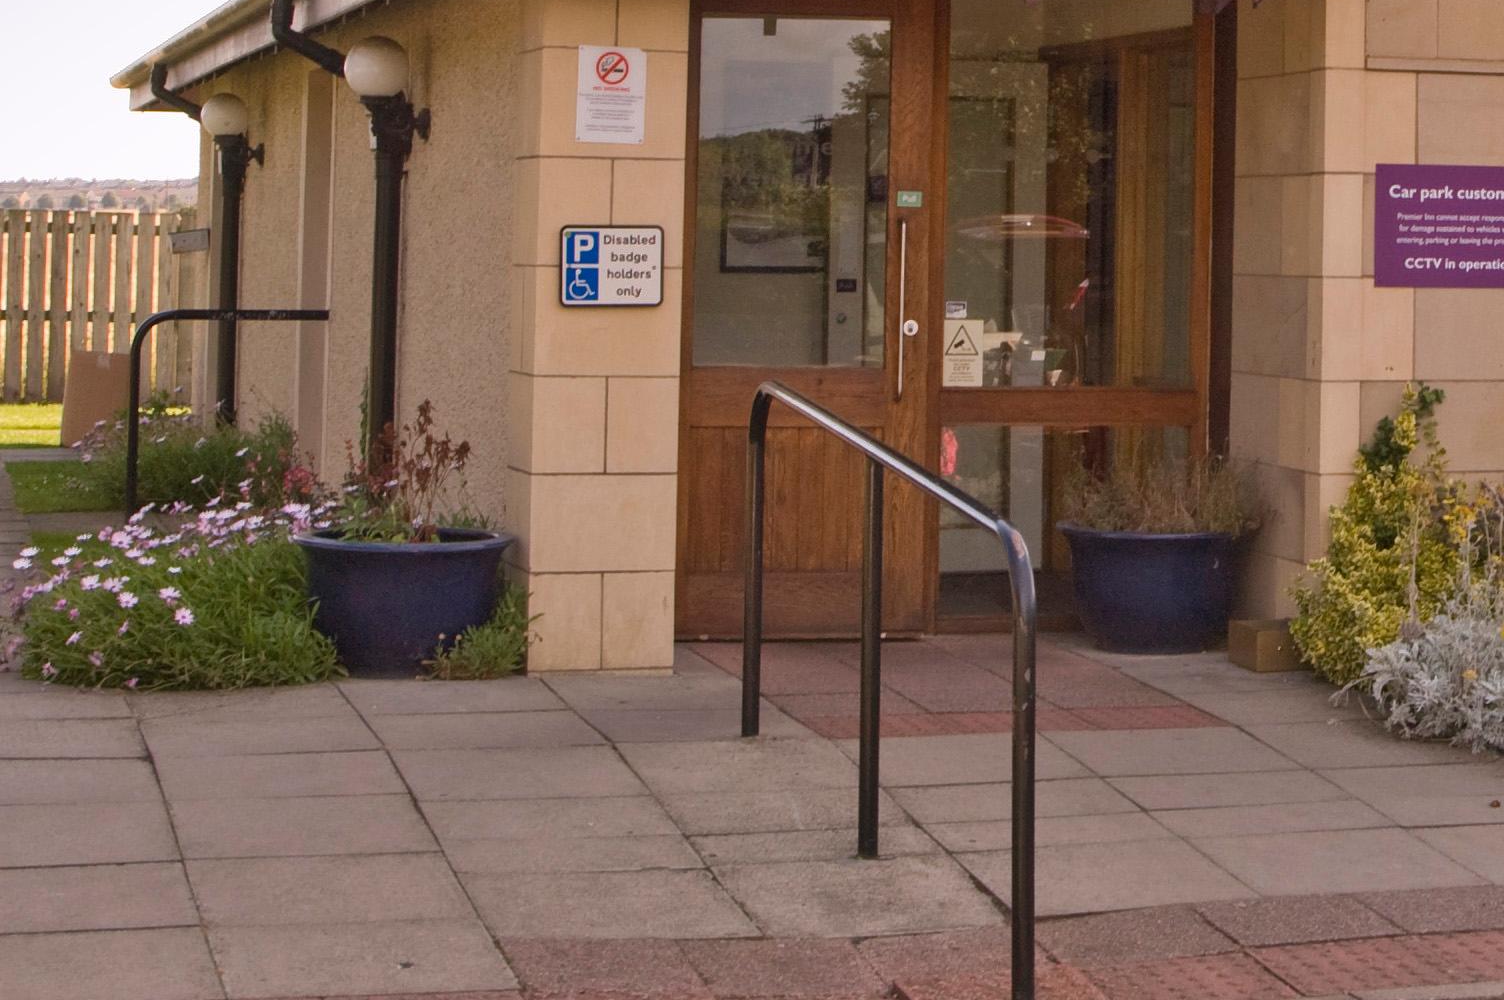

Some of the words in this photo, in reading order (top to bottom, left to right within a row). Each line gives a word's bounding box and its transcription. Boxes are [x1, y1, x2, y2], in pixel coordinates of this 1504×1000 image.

[1389, 185, 1416, 198] Car
[1420, 186, 1453, 202] park
[1397, 212, 1423, 221] Premier
[1460, 214, 1480, 222] accept
[1399, 224, 1409, 232] for
[1410, 225, 1434, 234] damage
[1436, 225, 1465, 233] sustained
[604, 235, 656, 245] Disabled
[1425, 237, 1449, 245] parking
[1460, 238, 1481, 246] leaving
[574, 234, 594, 262] P
[611, 252, 648, 263] badge
[1405, 258, 1442, 270] CCTV
[1445, 258, 1455, 269] in
[617, 286, 642, 297] only
